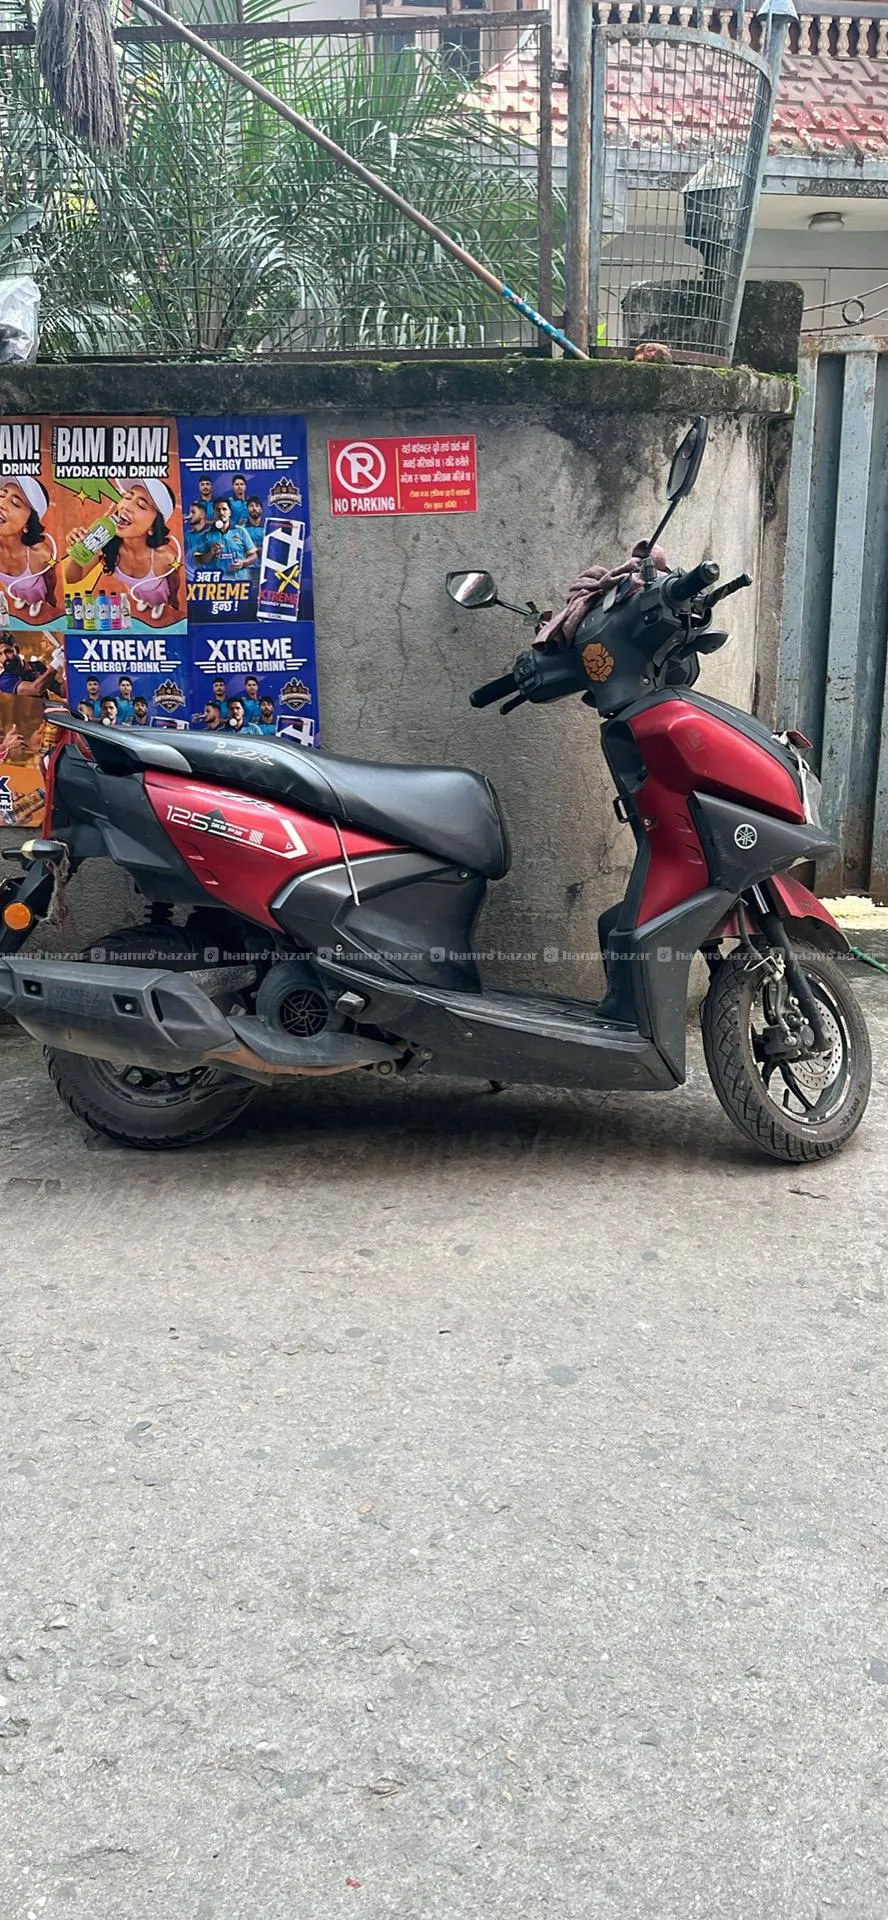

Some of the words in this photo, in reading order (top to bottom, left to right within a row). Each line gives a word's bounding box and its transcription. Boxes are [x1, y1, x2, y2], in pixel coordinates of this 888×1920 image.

[58, 427, 106, 463] BAM
[112, 427, 169, 463] BAM!
[193, 434, 283, 458] XTREME
[2, 463, 40, 475] DRINK
[56, 465, 126, 478] HYDRATION
[129, 465, 168, 478] DRINK
[203, 458, 242, 471] ENERGY
[244, 458, 276, 470] DRINK
[334, 498, 349, 512] NO
[351, 496, 395, 511] PARKING
[186, 583, 250, 601] XTREME
[81, 638, 167, 661] XTREME
[206, 638, 293, 661] XTREME
[90, 661, 127, 673] ENERGY
[130, 661, 160, 673] DRINK
[216, 661, 253, 673] ENERGY
[256, 661, 286, 672] DRINK
[166, 805, 211, 831] 125
